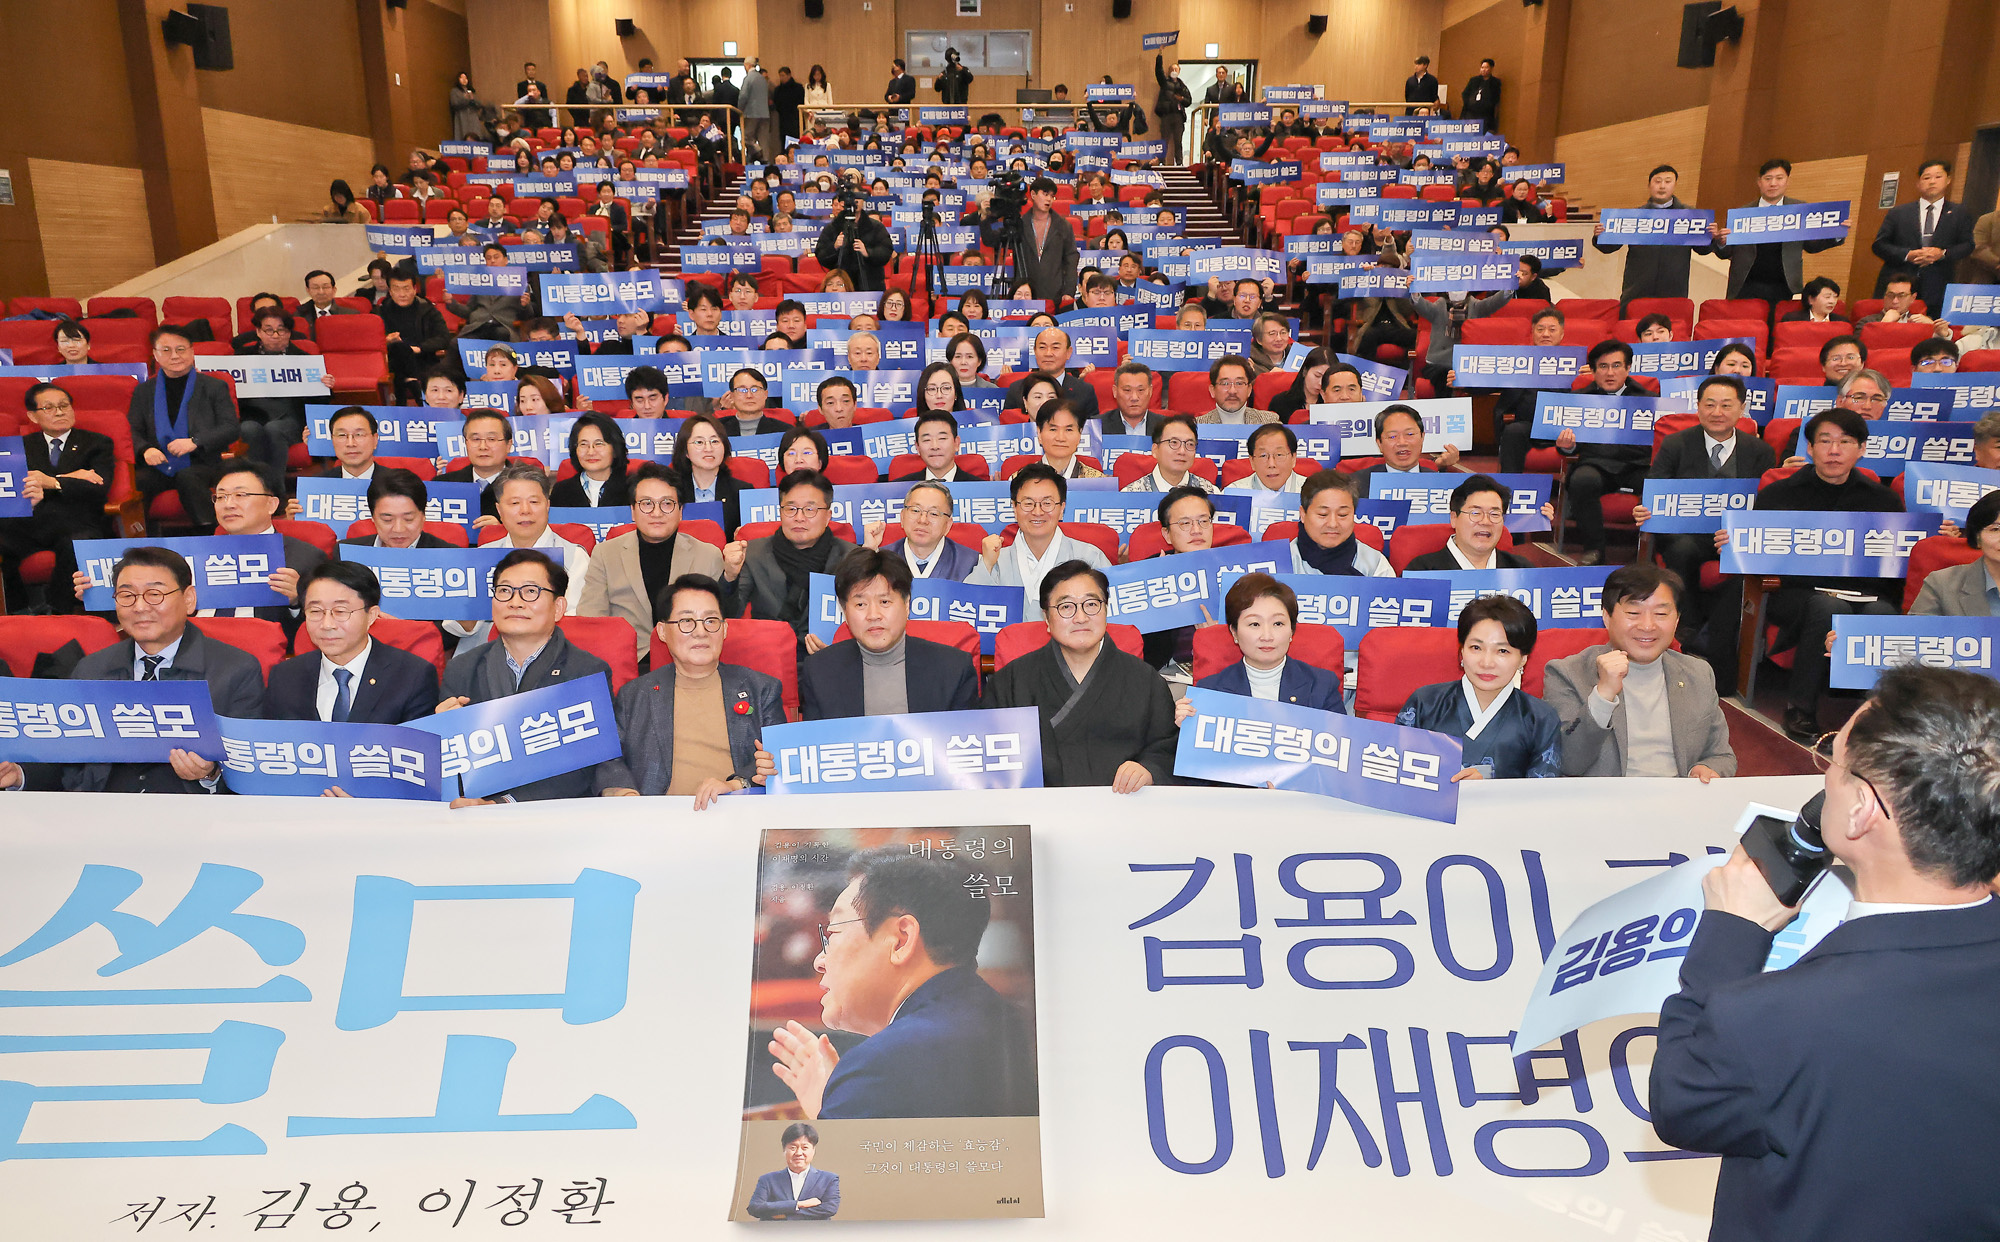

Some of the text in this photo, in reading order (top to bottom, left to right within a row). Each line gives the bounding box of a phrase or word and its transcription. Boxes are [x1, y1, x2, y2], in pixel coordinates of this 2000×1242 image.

[1298, 91, 1312, 99] 쓸모
[1254, 111, 1269, 120] 쓸모
[1407, 127, 1421, 136] 쓸모
[1464, 123, 1480, 133] 쓸모
[1103, 138, 1118, 146] 쓸모
[1149, 144, 1163, 154] 쓸모
[1483, 141, 1500, 150] 쓸모
[1358, 155, 1374, 165] 쓸모
[1281, 167, 1297, 176] 쓸모
[1380, 170, 1396, 180] 쓸모
[1543, 168, 1560, 178] 쓸모
[555, 181, 573, 192] 쓸모
[1359, 187, 1377, 197] 쓸모
[1383, 209, 1456, 221] 대통령의 쓸모
[1475, 213, 1498, 226] 쓸모
[1733, 210, 1840, 233] 대통령의 쓸모
[1606, 218, 1707, 234] 대통령의 쓸모
[409, 234, 431, 247] 쓸모
[955, 232, 975, 243] 쓸모
[1416, 237, 1493, 253] 대통령의 쓸모
[1288, 241, 1329, 253] 대통령의
[1553, 247, 1577, 259] 쓸모
[549, 250, 573, 263] 쓸모
[685, 252, 756, 265] 대통령의 쓸모
[1196, 256, 1281, 274] 대통령의 쓸모
[449, 272, 522, 287] 대통령의 쓸모
[1417, 264, 1512, 281] 대통령의 쓸모
[1341, 276, 1407, 289] 대통령의 쓸모
[548, 281, 655, 303] 대통령의 쓸모
[850, 300, 877, 316] 쓸모
[1119, 313, 1149, 331] 쓸모
[885, 340, 918, 358] 쓸모
[1076, 337, 1109, 355] 쓸모
[1134, 340, 1203, 359] 대통령의
[535, 350, 572, 369] 쓸모
[987, 348, 1021, 367] 쓸모
[1460, 355, 1577, 375] 대통령의 쓸모
[270, 368, 302, 382] 너머
[664, 363, 702, 385] 쓸모
[1361, 371, 1395, 396] 쓸모
[874, 383, 912, 403] 쓸모
[1542, 405, 1627, 430] 대통령의
[1888, 401, 1940, 421] 쓸모
[1921, 438, 1975, 462] 쓸모
[1733, 526, 1854, 556] 대통령의
[205, 553, 271, 586] 쓸모
[949, 599, 1007, 634] 쓸모
[1368, 596, 1433, 628] 쓸모
[1846, 635, 1992, 669] 대통령의
[111, 703, 201, 739] 쓸모
[520, 700, 600, 759] 쓸모
[780, 732, 1024, 785] 대통령의 쓸모
[1194, 714, 1441, 792] 대통령의 쓸모
[348, 743, 426, 787] 쓸모
[908, 837, 1014, 860] 대통령의
[772, 853, 829, 864] 이재명의 시간
[962, 873, 1019, 899] 쓸모
[1127, 849, 1557, 992] 김용이
[0, 862, 642, 1163] 쓸모
[859, 1140, 897, 1153] 국민이
[903, 1140, 954, 1153] 체감하는
[865, 1160, 1004, 1174] 그것이 대통령의 쓸모다
[108, 1177, 615, 1233] 저자. 김용, 이정환
